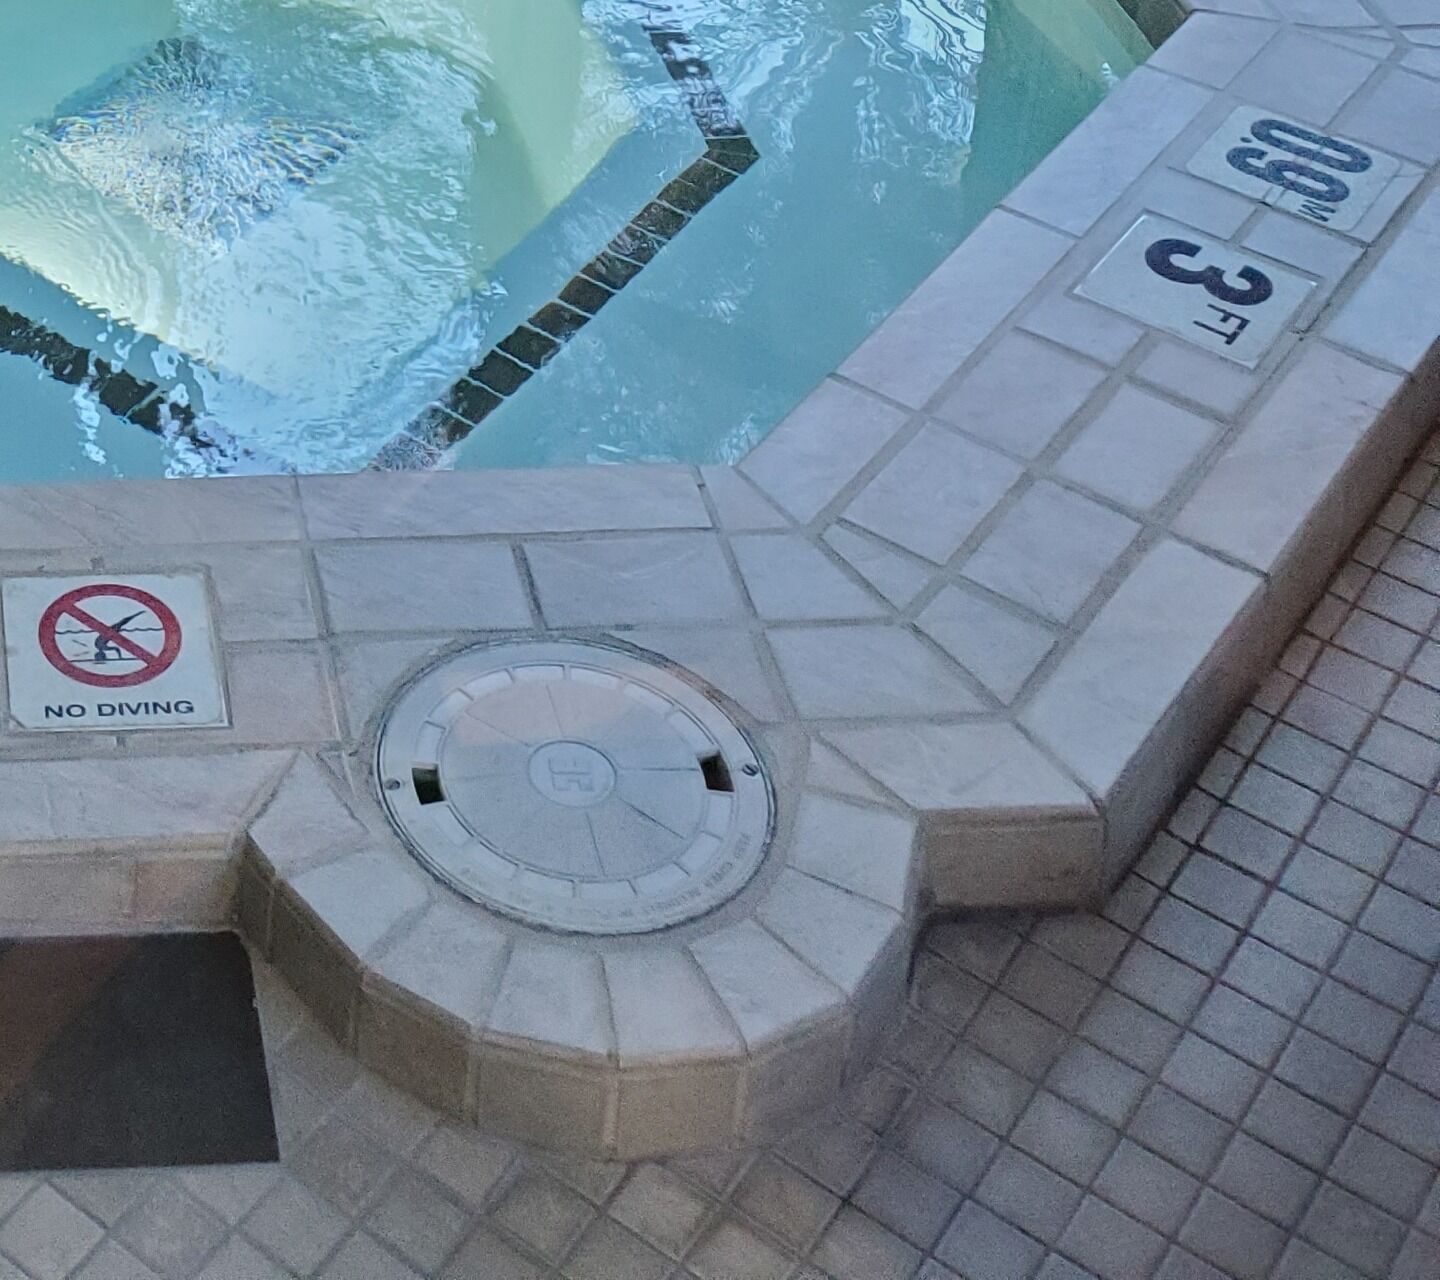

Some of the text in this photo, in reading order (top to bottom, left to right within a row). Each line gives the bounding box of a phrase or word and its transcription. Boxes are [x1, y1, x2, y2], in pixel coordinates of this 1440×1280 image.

[1144, 238, 1274, 345] 3 FT
[44, 700, 195, 719] NO DIVING
